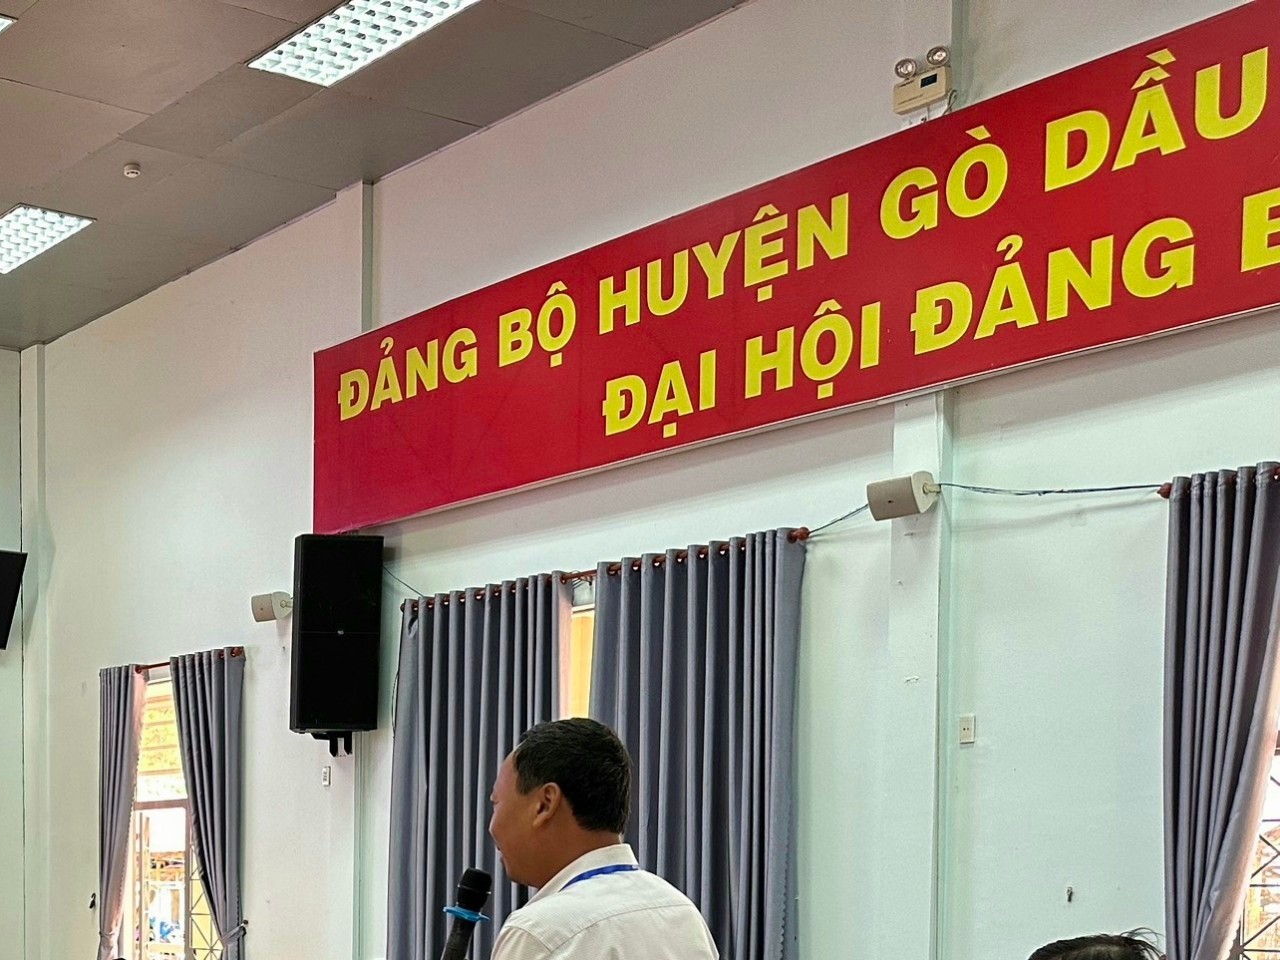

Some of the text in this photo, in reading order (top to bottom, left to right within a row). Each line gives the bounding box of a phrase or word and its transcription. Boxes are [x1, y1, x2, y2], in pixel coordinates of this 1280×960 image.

[338, 46, 1269, 421] ĐẢNG BỘ HUYỆN GÒ DẦU
[602, 349, 716, 438] ĐẠI
[744, 299, 881, 400] HỘI
[909, 217, 1196, 356] ĐẢNG
